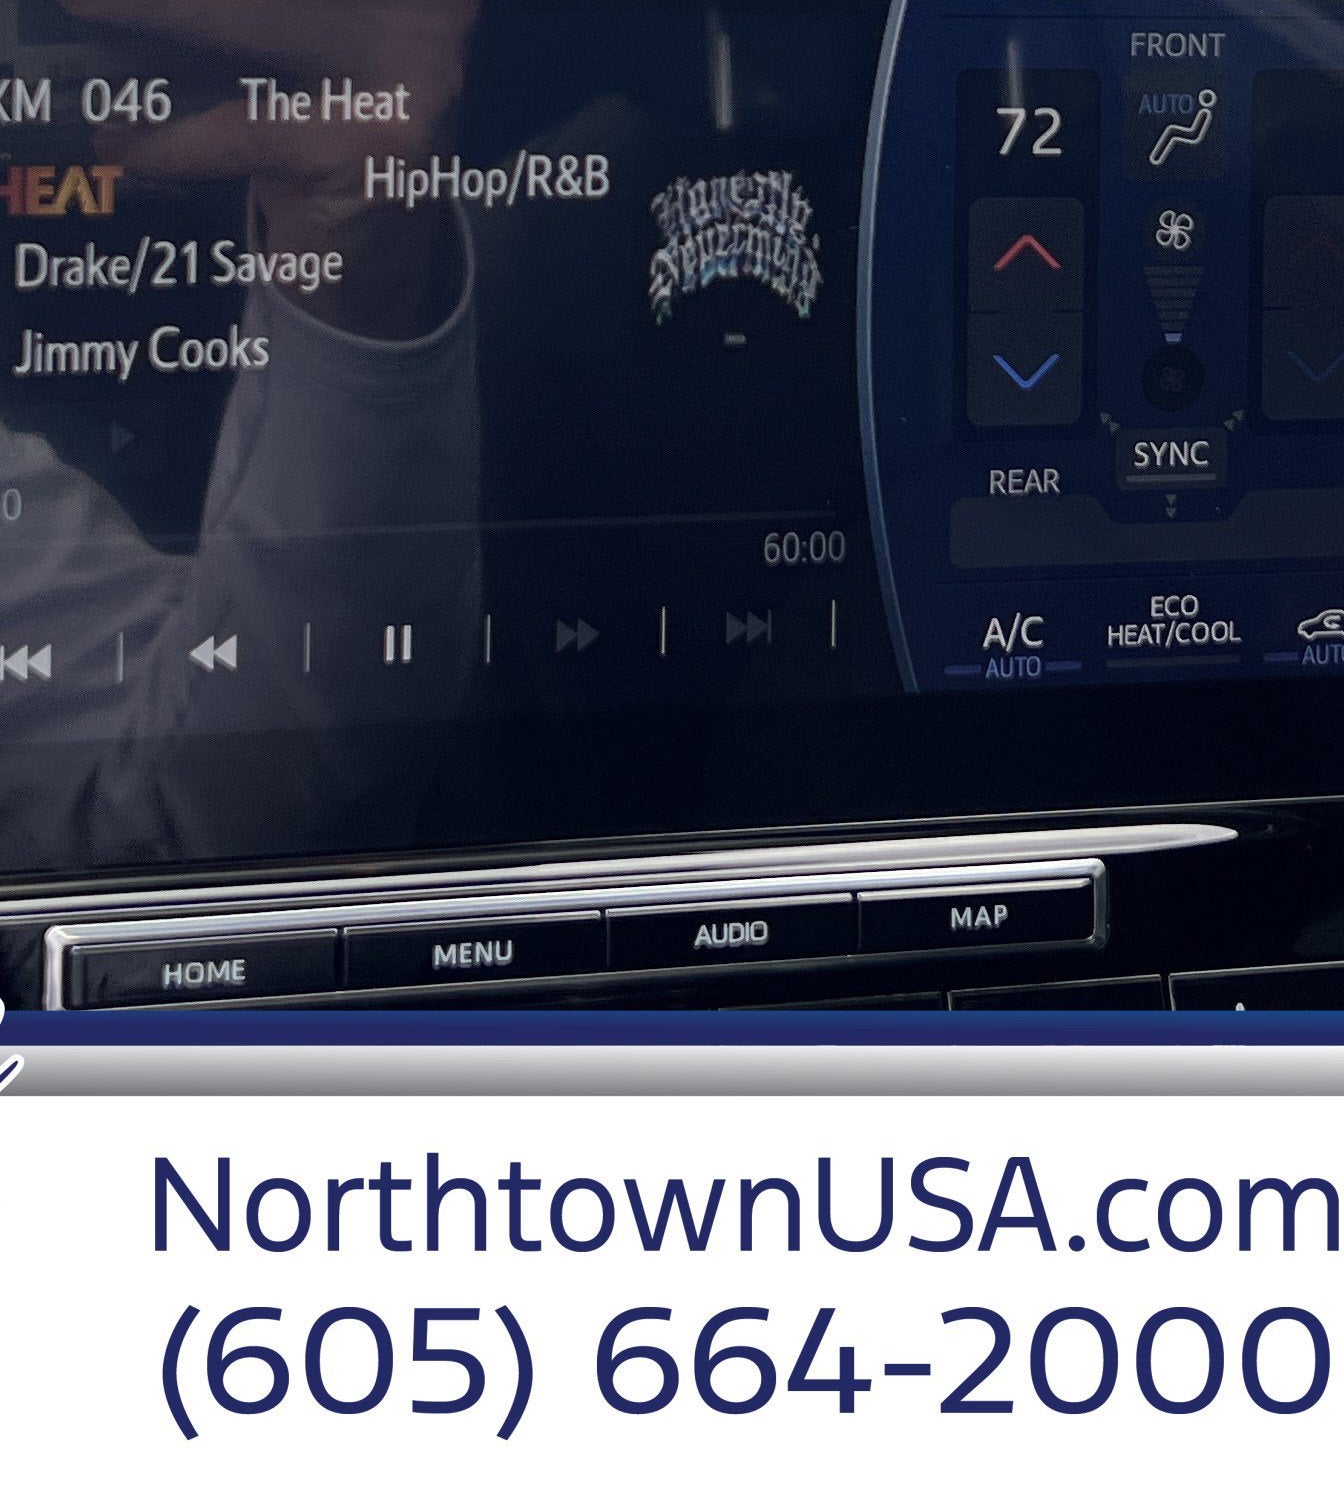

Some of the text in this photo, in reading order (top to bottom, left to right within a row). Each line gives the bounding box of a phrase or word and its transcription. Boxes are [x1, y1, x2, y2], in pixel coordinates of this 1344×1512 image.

[1130, 31, 1226, 59] FRONT
[82, 77, 173, 123] 046
[238, 76, 411, 122] The Heat
[1138, 92, 1194, 115] AUTO
[996, 106, 1063, 156] 72
[362, 150, 611, 208] HipHop/R&B
[14, 236, 345, 295] Drake/21 Savage
[13, 325, 270, 383] Jimmy Cooks
[1133, 439, 1210, 469] SYNC
[989, 467, 1061, 496] REAR
[762, 530, 846, 566] 60:00
[1150, 594, 1200, 619] ECO
[982, 612, 1044, 652] A/C
[1107, 619, 1242, 650] HEAT/COOL
[985, 655, 1043, 679] AUTO
[948, 901, 1010, 930] MAP
[693, 918, 770, 948] AUDIO
[432, 939, 515, 971] MENU
[162, 956, 248, 989] HOME
